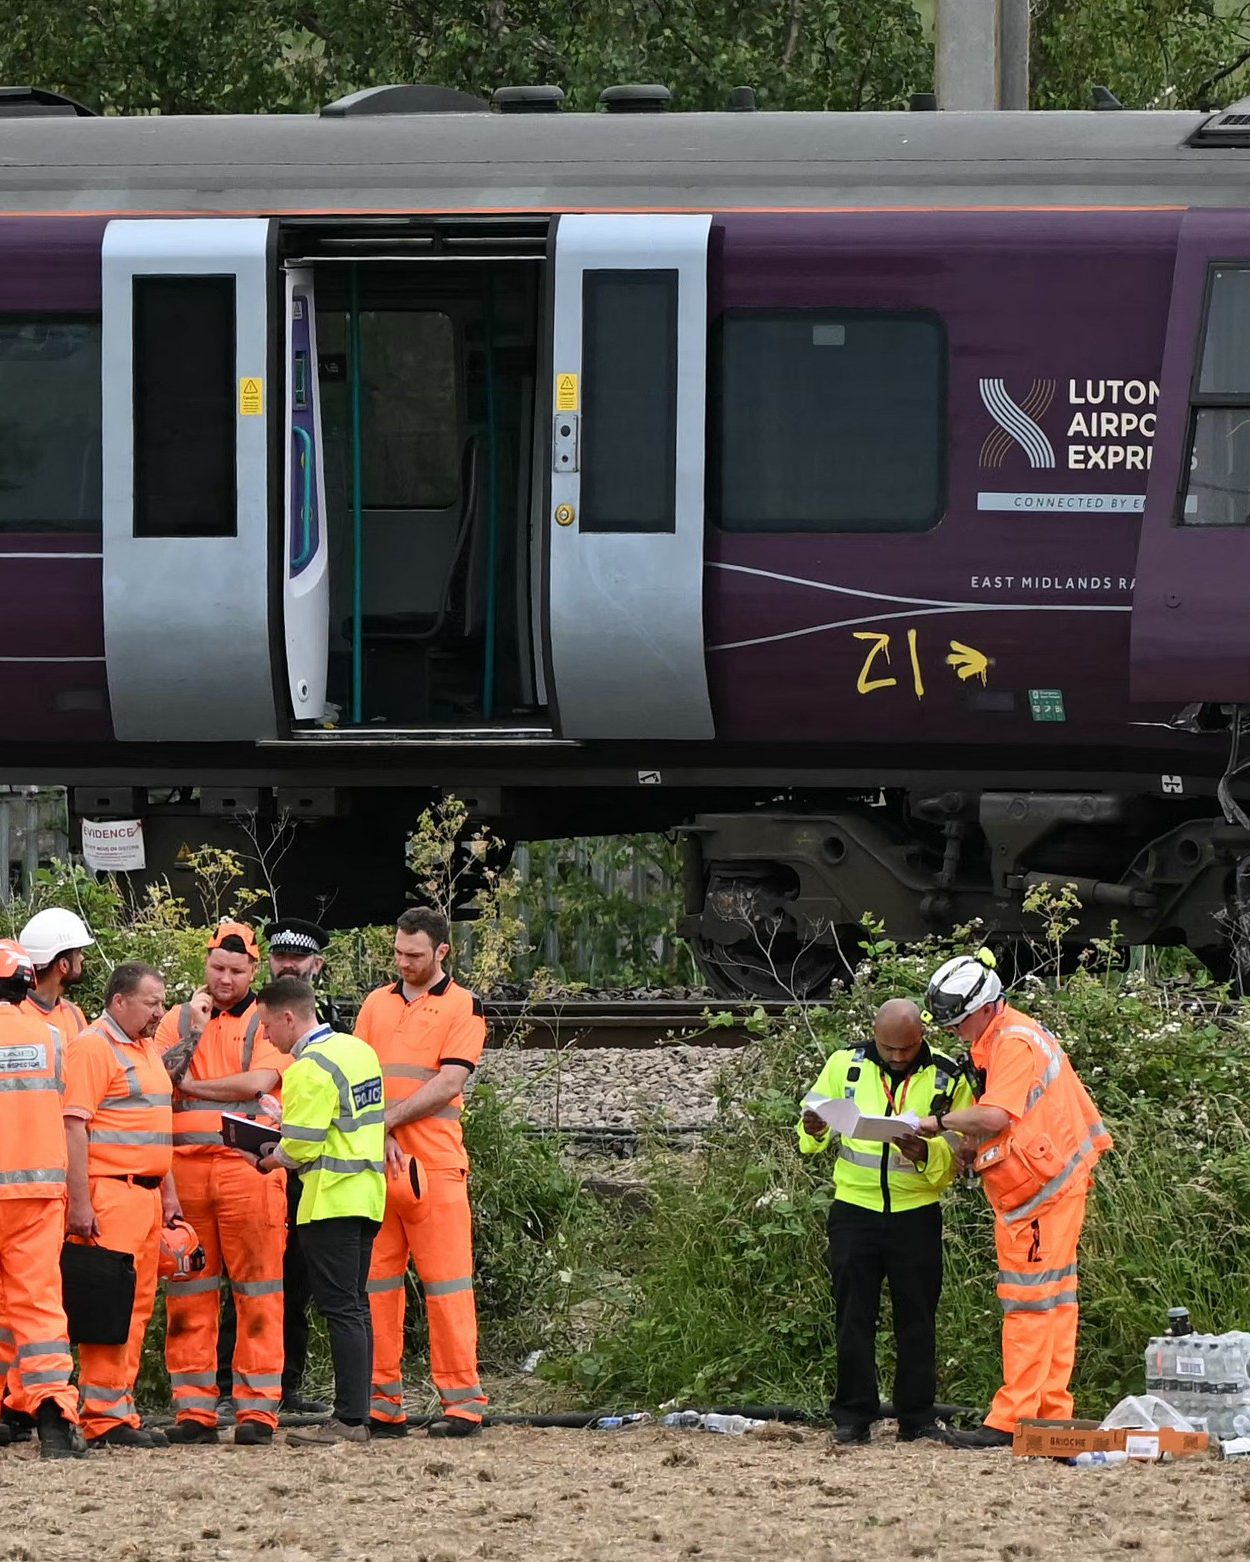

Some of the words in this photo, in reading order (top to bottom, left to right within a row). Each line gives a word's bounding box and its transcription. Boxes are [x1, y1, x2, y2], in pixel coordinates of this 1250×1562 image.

[1069, 379, 1160, 405] LUTON
[1014, 497, 1104, 509] CONNECTED
[1111, 498, 1127, 508] BY
[1133, 498, 1147, 509] E
[971, 576, 1015, 588] EAST
[1021, 576, 1112, 589] MIDLANDS
[84, 826, 135, 839] EVIDENCE
[355, 1087, 382, 1109] POIC
[1050, 1437, 1087, 1448] BRIOCHE
